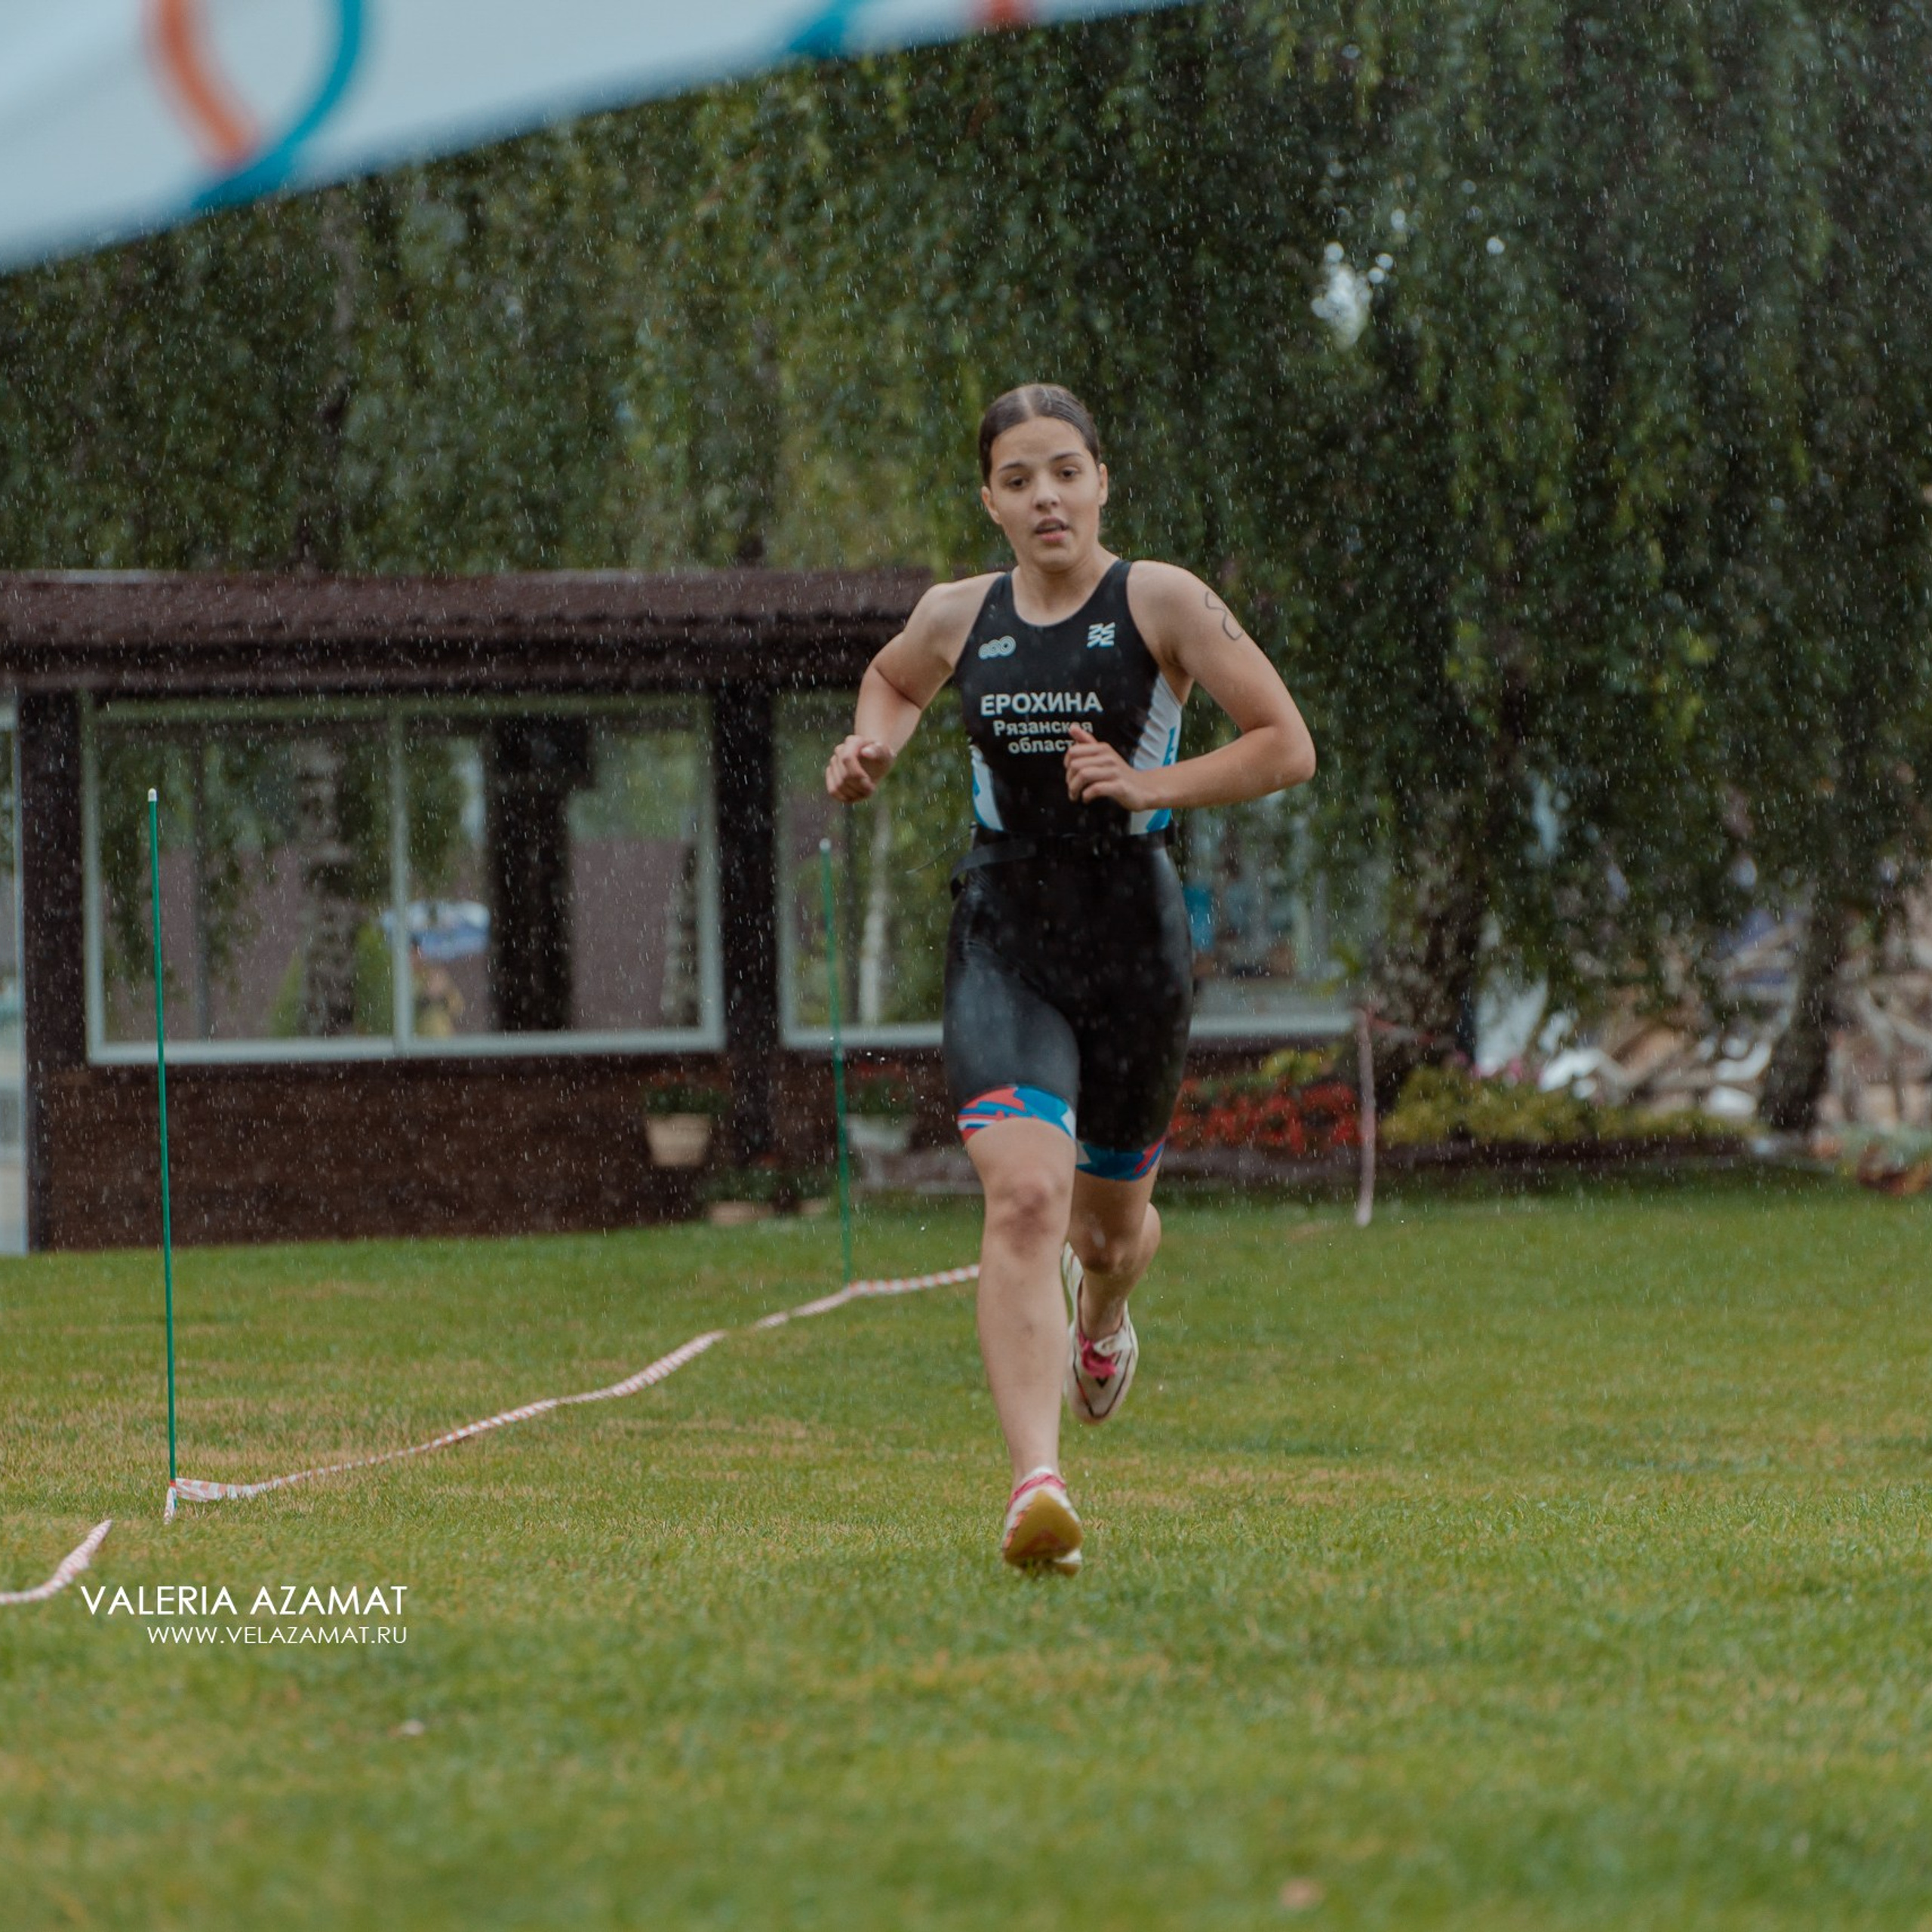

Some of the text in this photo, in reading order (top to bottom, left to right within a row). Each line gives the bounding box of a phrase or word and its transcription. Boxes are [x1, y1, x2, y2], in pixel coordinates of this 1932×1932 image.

[981, 691, 1103, 715] ЕРОХИНА
[993, 720, 1094, 736] Рязанскя
[1008, 737, 1075, 753] област
